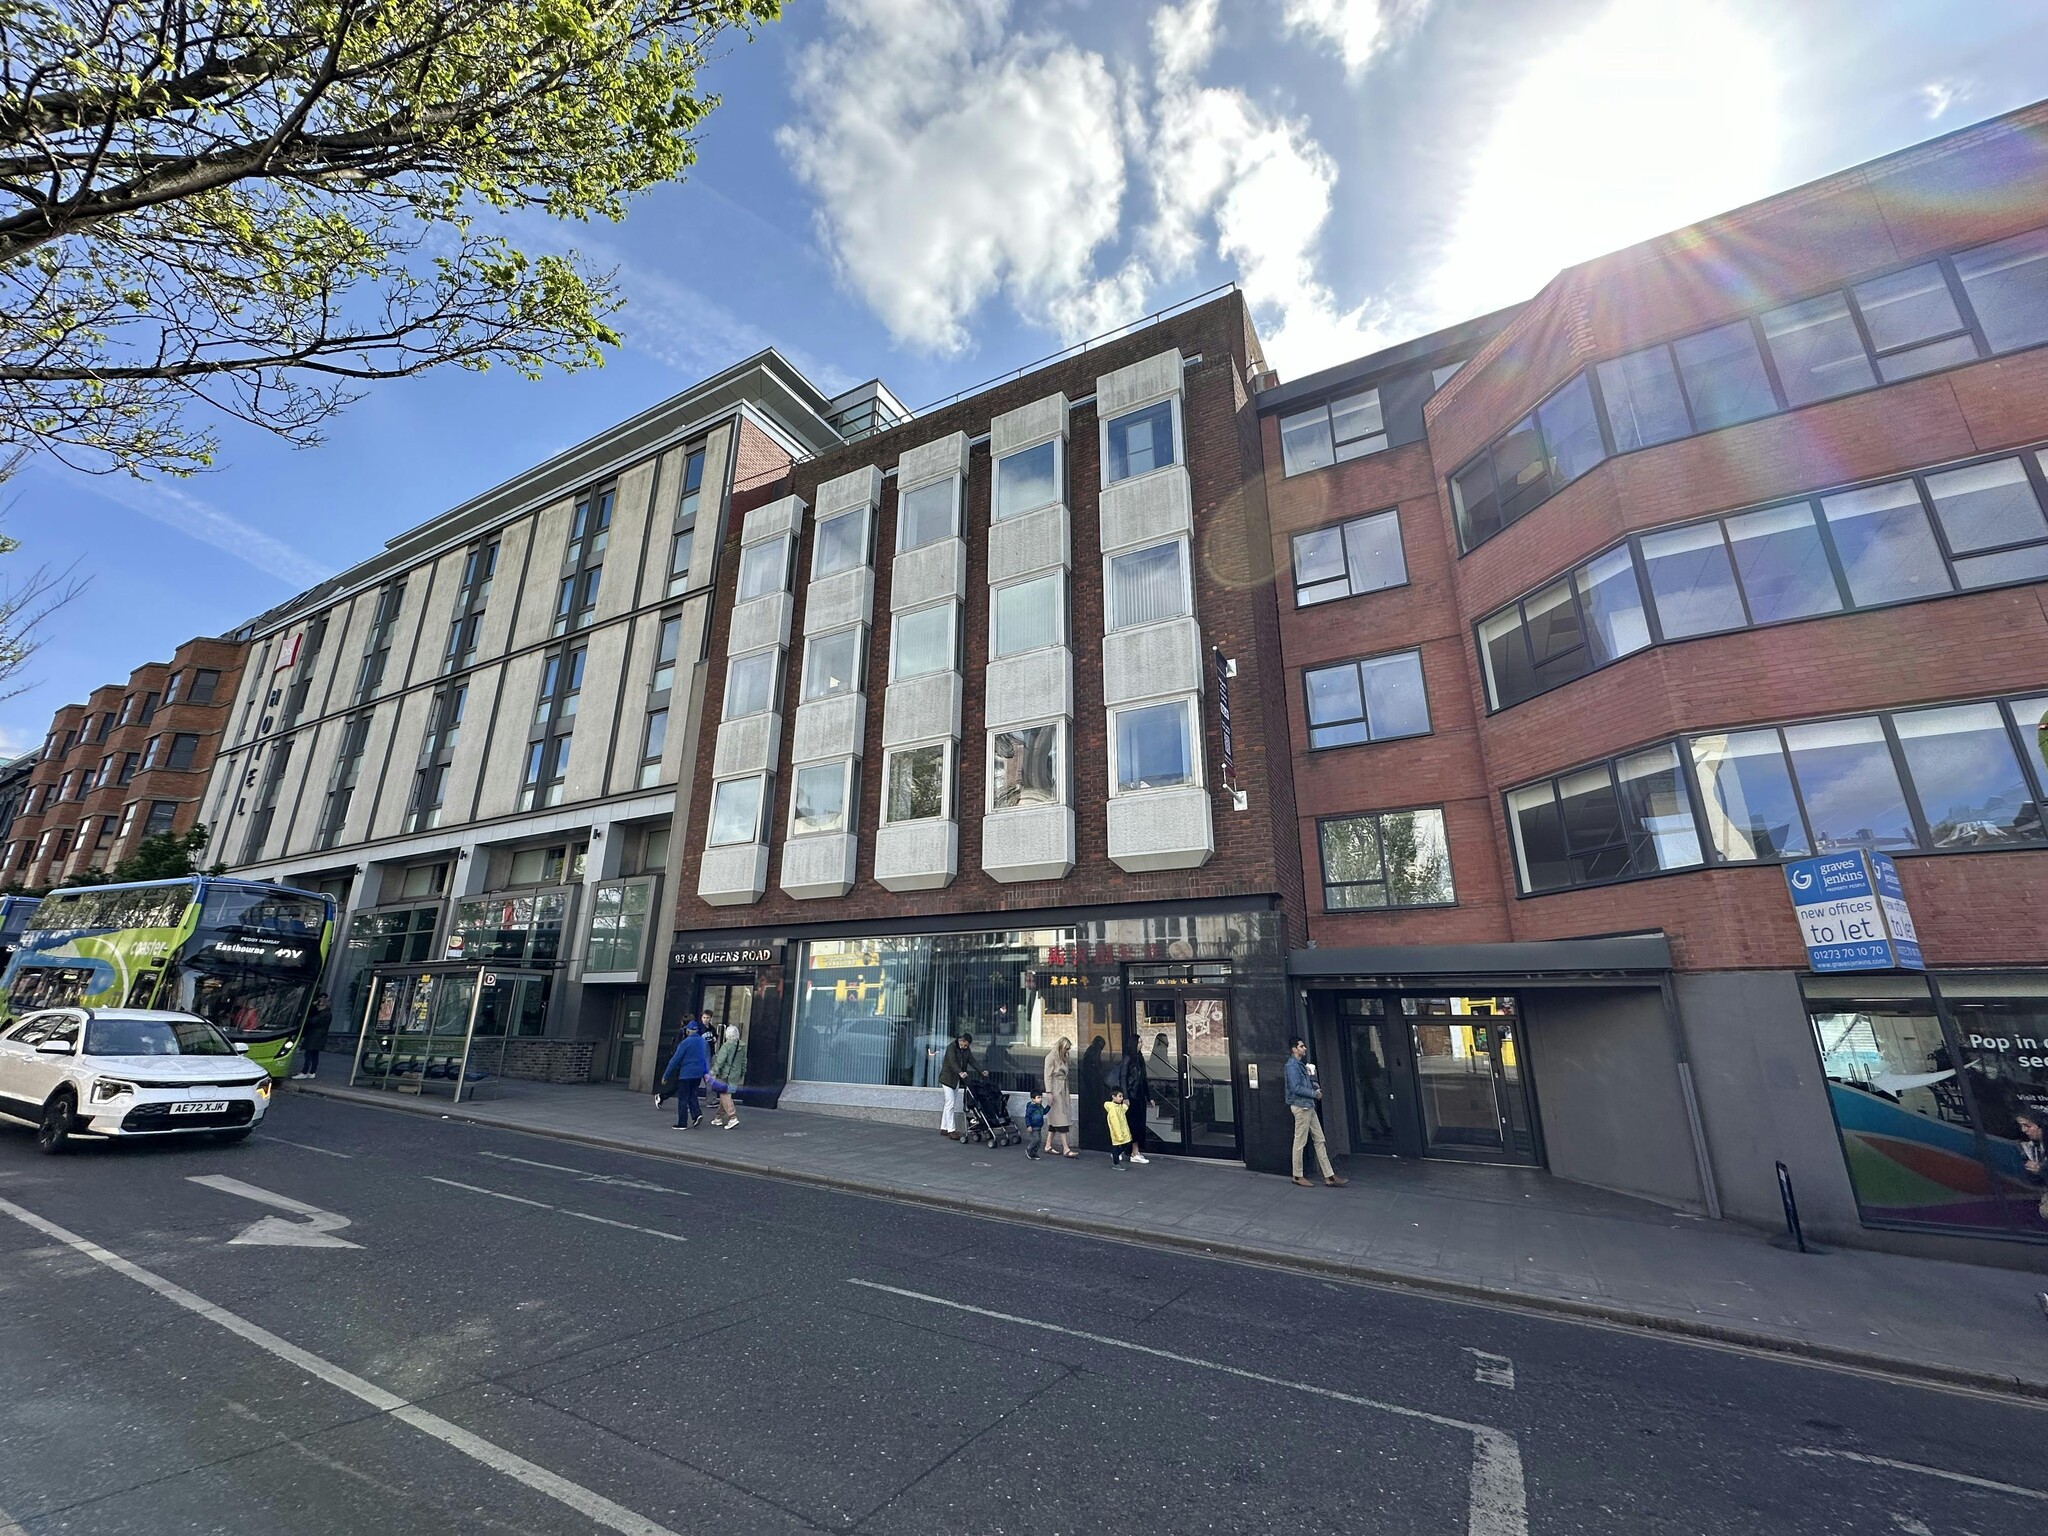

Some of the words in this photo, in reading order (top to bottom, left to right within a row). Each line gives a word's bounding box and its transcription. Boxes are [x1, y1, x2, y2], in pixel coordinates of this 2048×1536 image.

[238, 688, 282, 816] HOTEL
[1820, 859, 1855, 875] graves
[1823, 870, 1864, 887] jenkins
[1801, 908, 1825, 919] new
[1829, 901, 1873, 916] offices
[1810, 924, 1834, 944] to
[1840, 918, 1875, 941] let
[215, 942, 265, 955] Eastbourne
[700, 951, 740, 964] QUEENS
[741, 949, 771, 962] ROAD
[1814, 950, 1841, 959] 01273
[1842, 948, 1855, 957] 70
[1857, 947, 1868, 956] 10
[1870, 946, 1884, 955] 70
[1969, 1034, 2010, 1052] Pop
[2014, 1033, 2037, 1049] in
[174, 1103, 203, 1113] AE72
[203, 1102, 225, 1111] XJK
